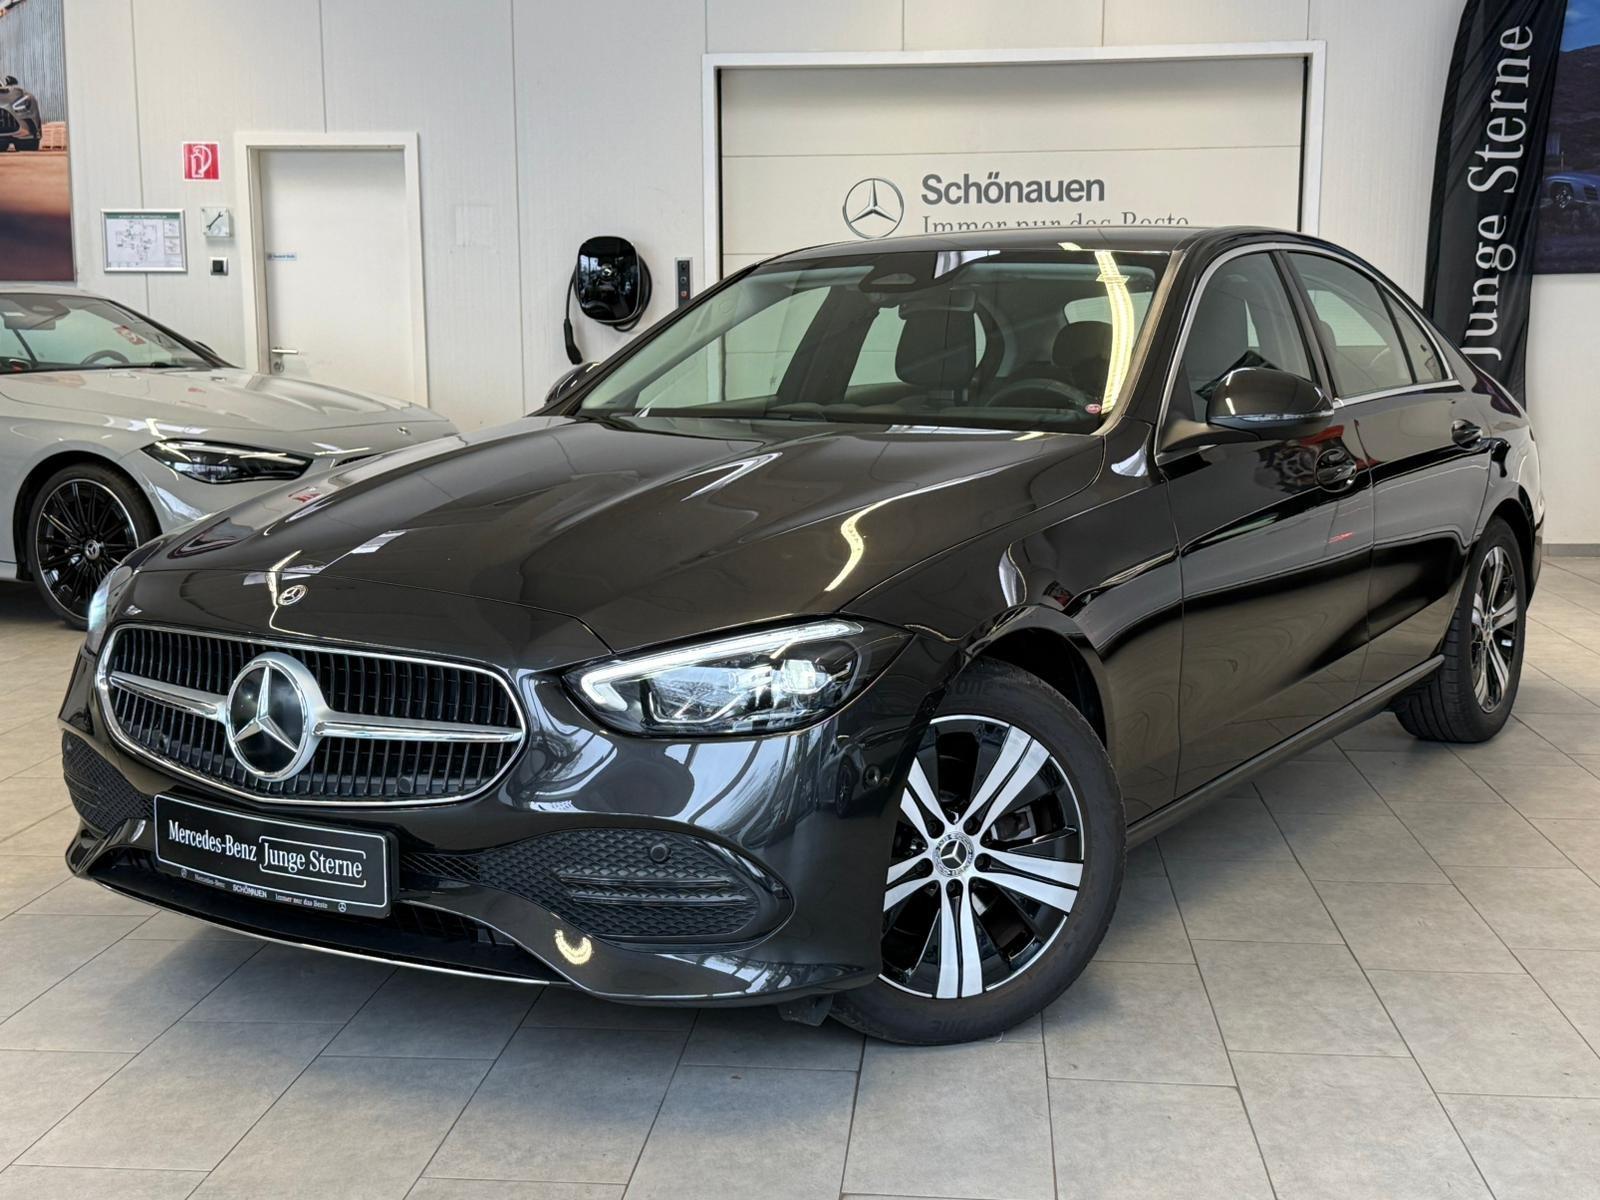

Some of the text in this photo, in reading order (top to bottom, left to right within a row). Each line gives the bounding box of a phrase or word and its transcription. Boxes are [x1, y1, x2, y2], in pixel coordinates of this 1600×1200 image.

[921, 171, 1105, 205] Schönauen
[1459, 25, 1533, 361] Junge Sterne
[168, 819, 363, 878] Mercedes-Benz Junge Sterne
